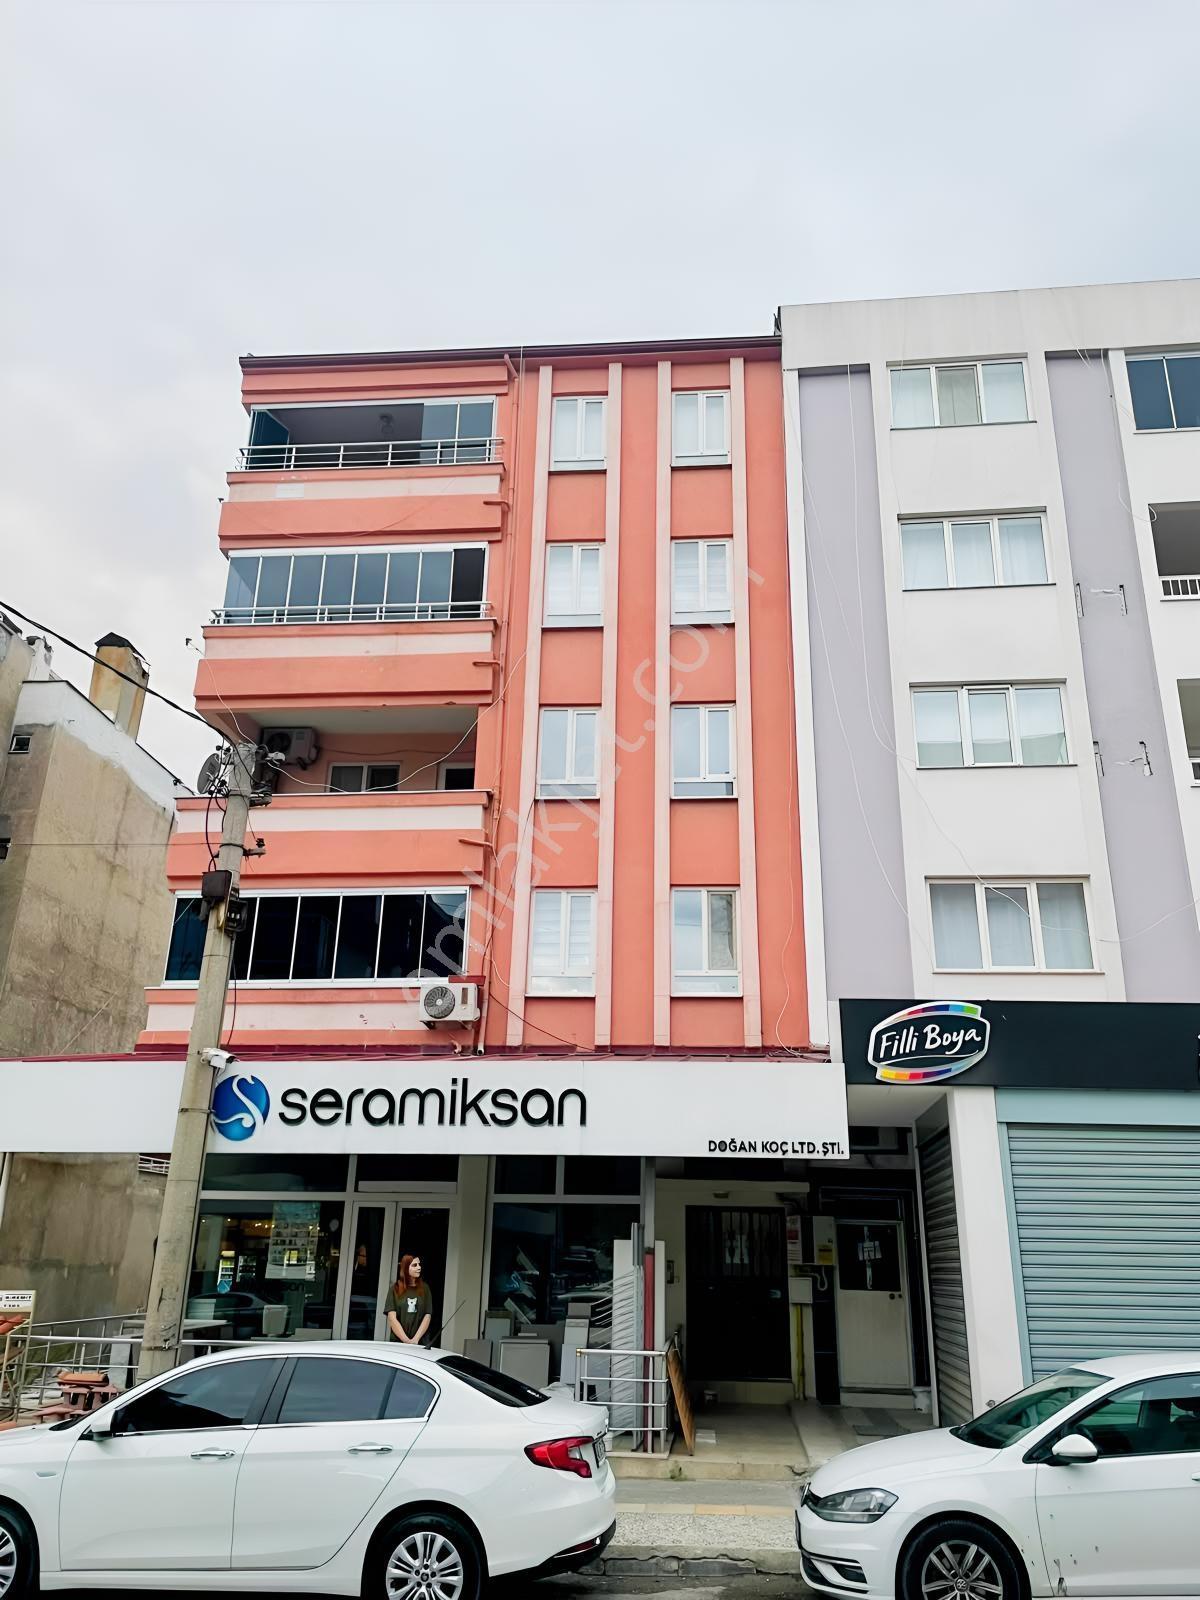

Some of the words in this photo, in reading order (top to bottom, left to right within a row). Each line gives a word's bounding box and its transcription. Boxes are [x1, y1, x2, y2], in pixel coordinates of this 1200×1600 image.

[880, 1026, 919, 1058] Filli
[923, 1024, 981, 1054] Boya
[278, 1078, 587, 1127] seramiksan
[708, 1138, 757, 1153] DOĞAN
[761, 1141, 789, 1156] KOÇ
[791, 1141, 820, 1154] LTD.
